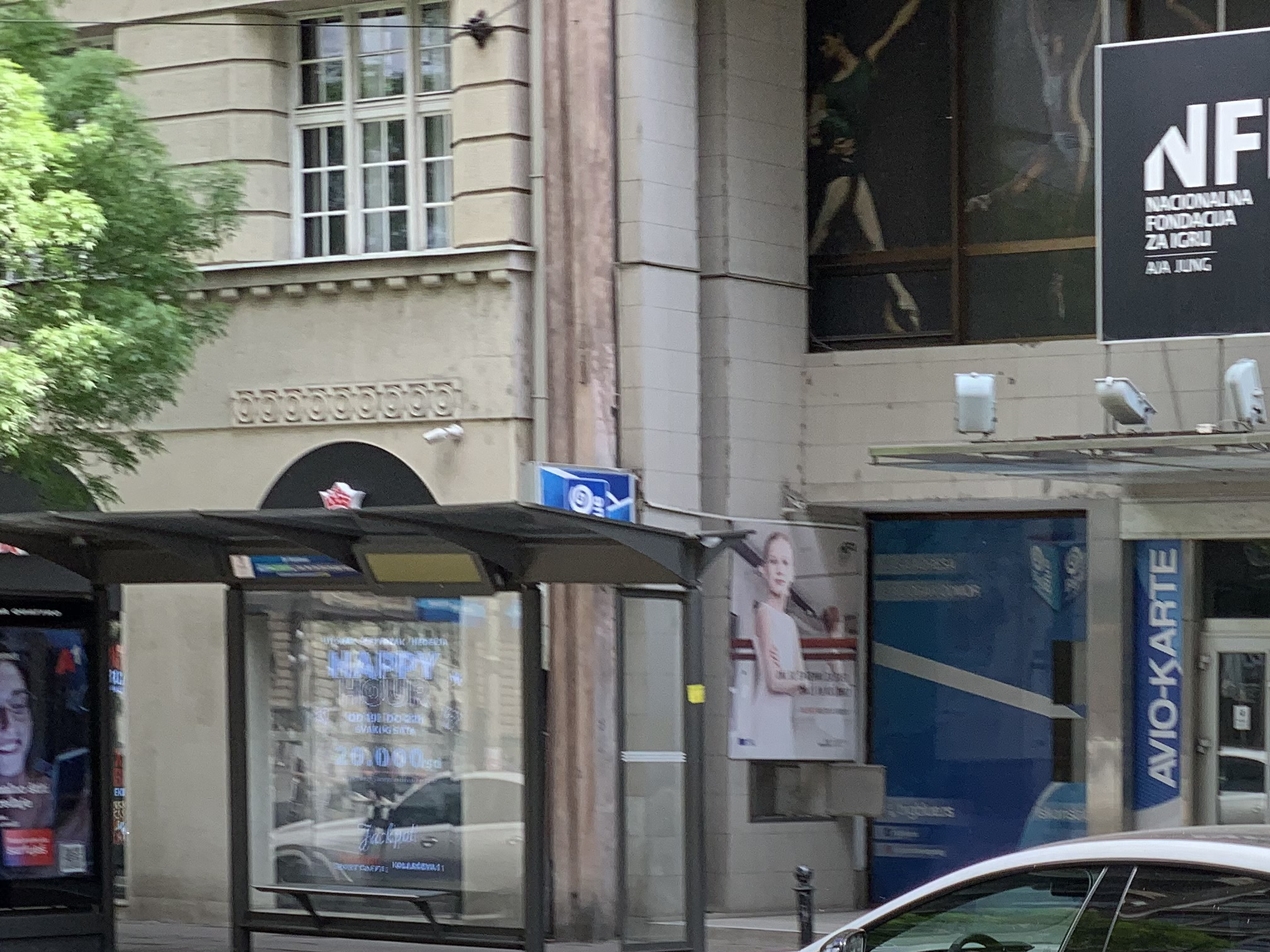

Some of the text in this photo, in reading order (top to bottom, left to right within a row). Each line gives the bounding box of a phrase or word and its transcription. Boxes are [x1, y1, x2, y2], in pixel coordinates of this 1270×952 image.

[1144, 189, 1254, 212] NACIONALNA
[1144, 209, 1238, 231] FONDACIJA
[1144, 230, 1212, 250] ZA IGRU
[1144, 257, 1212, 275] AJA JUNG
[328, 650, 440, 679] HAPPY
[1147, 548, 1179, 788] AVIO-KARTE
[338, 678, 431, 708] HOUR
